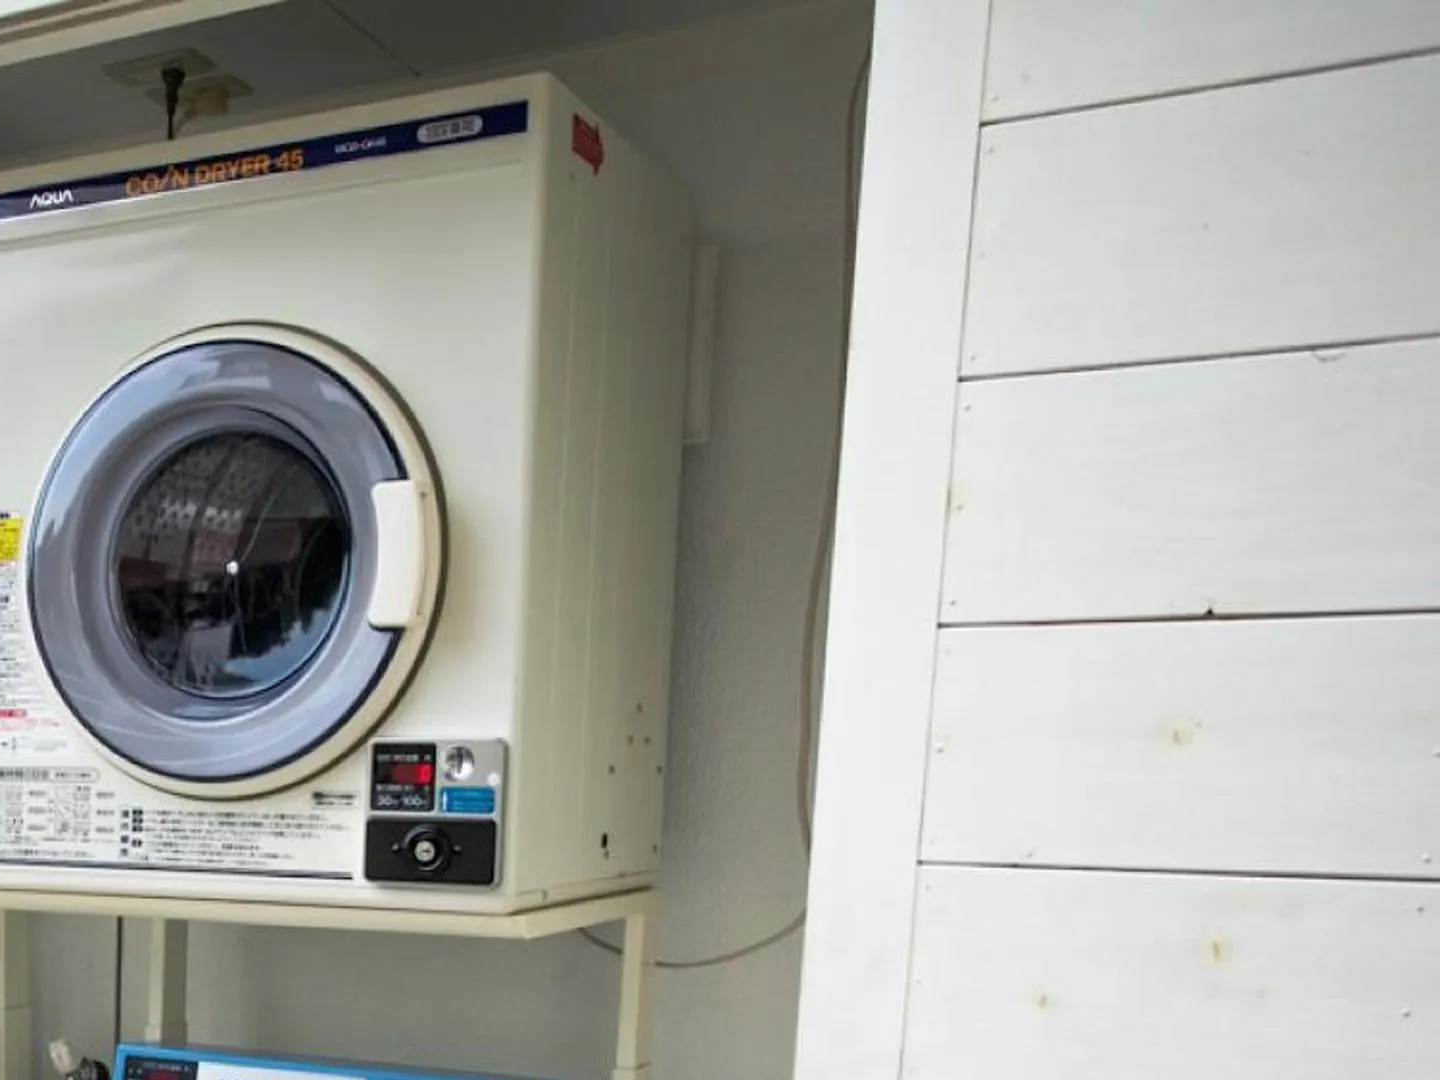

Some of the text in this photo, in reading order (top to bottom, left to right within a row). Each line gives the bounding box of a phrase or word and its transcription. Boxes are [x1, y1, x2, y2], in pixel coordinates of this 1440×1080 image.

[30, 189, 74, 208] AQUA
[195, 153, 269, 184] DRYER
[275, 149, 303, 171] 45
